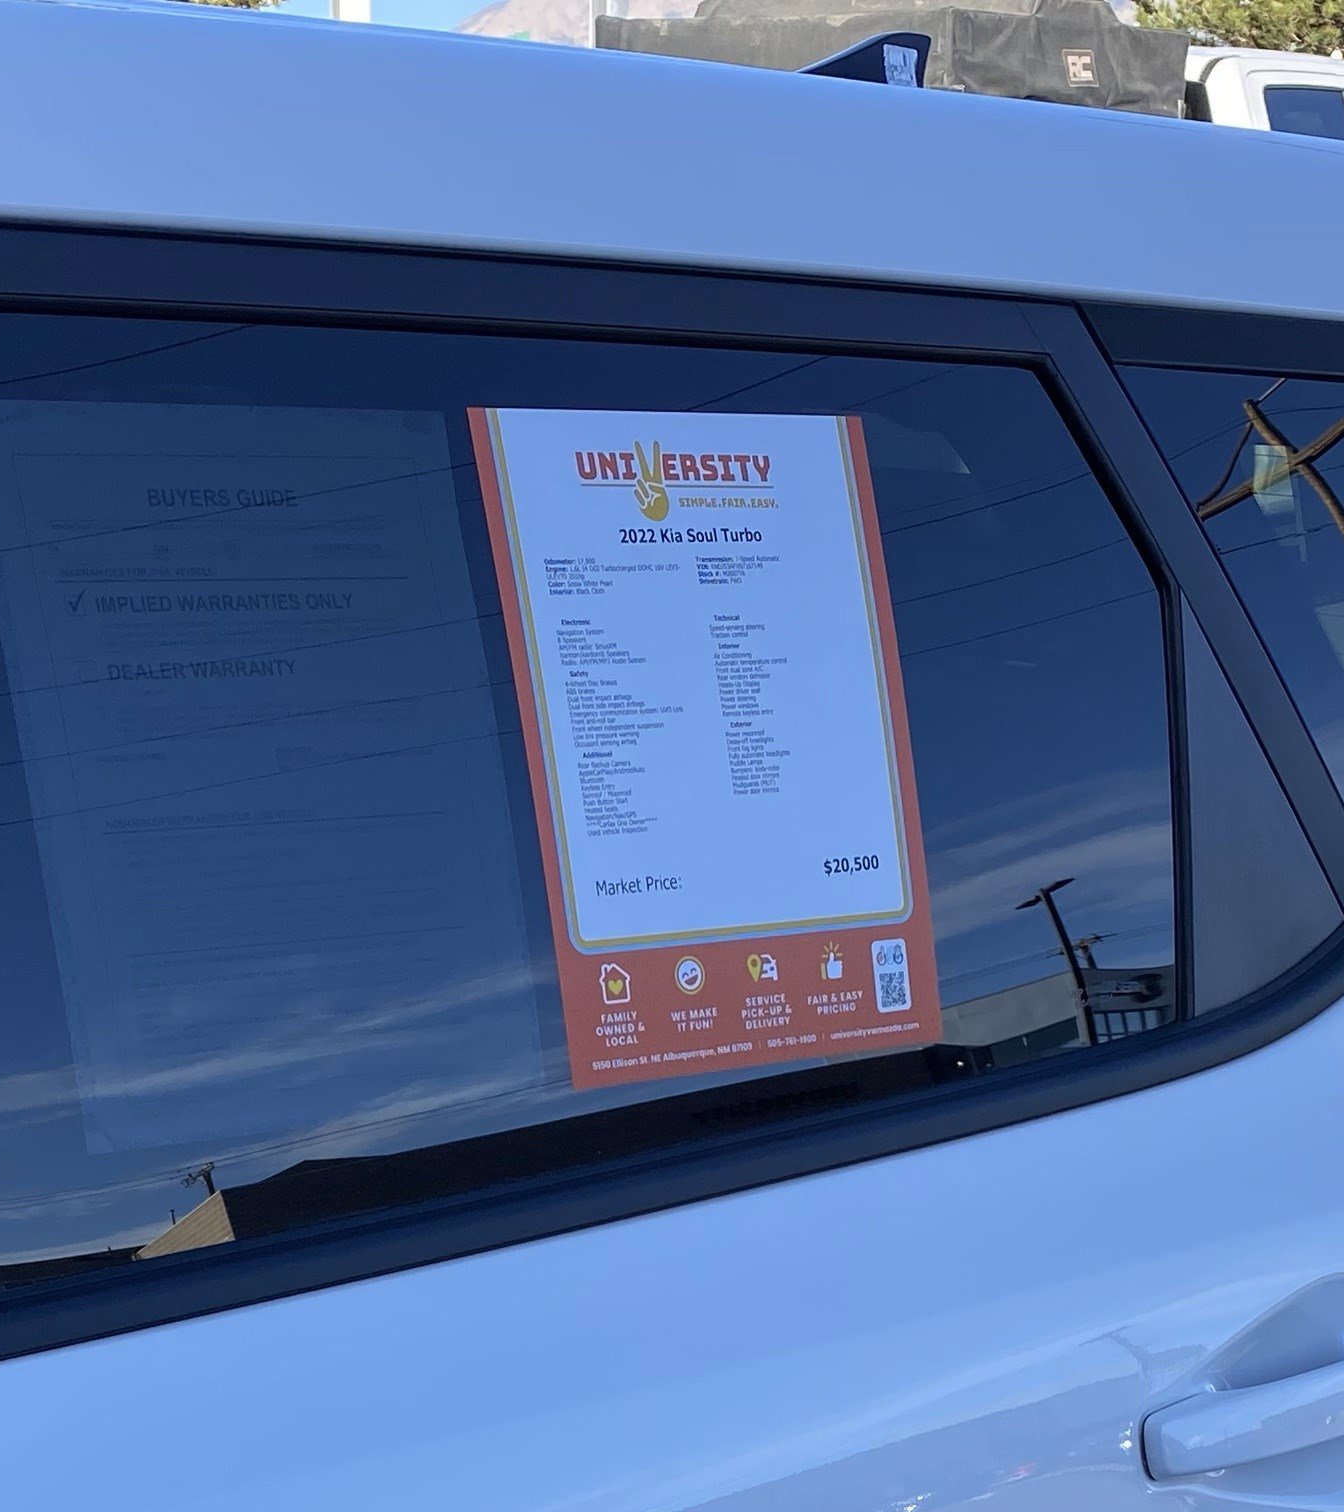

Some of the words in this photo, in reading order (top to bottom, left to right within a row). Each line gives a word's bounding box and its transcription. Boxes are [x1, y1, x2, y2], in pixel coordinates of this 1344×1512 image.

[1067, 55, 1093, 81] RC
[147, 489, 230, 508] BUYERS
[237, 488, 300, 507] GUIDE
[619, 529, 658, 544] 2022
[660, 529, 683, 543] Kia
[686, 528, 719, 543] Soul
[721, 528, 763, 543] Turbo
[95, 594, 174, 612] IMPLIED
[178, 593, 300, 611] WARRANTIES
[307, 593, 352, 611] ONLY
[109, 661, 186, 680] DEALER
[190, 660, 296, 679] WARRANTY
[569, 670, 589, 679] Safety
[583, 750, 614, 759] Additional
[824, 854, 880, 877] $20,500
[596, 878, 642, 897] Market
[646, 876, 683, 892] Price:
[744, 993, 787, 1007] SERVICE
[807, 995, 829, 1006] FAIR
[830, 993, 837, 1003] &
[840, 990, 864, 1002] EASY
[601, 1010, 638, 1023] FAMILY
[670, 1010, 687, 1022] WE
[689, 1007, 718, 1020] MAKE
[741, 1006, 783, 1020] PICK-UP
[785, 1005, 793, 1015] &
[817, 1003, 857, 1016] PRICING
[596, 1022, 635, 1037] OWNED
[637, 1021, 646, 1032] &
[677, 1022, 688, 1033] IT
[690, 1019, 714, 1031] FUN!
[745, 1016, 791, 1030] DELIVERY
[830, 1022, 920, 1040] universityvwmazda.com
[605, 1035, 639, 1048] LOCAL
[612, 1057, 639, 1069] Ellison
[651, 1054, 662, 1064] NE
[663, 1047, 717, 1062] Albuquerque,
[717, 1045, 731, 1056] NM
